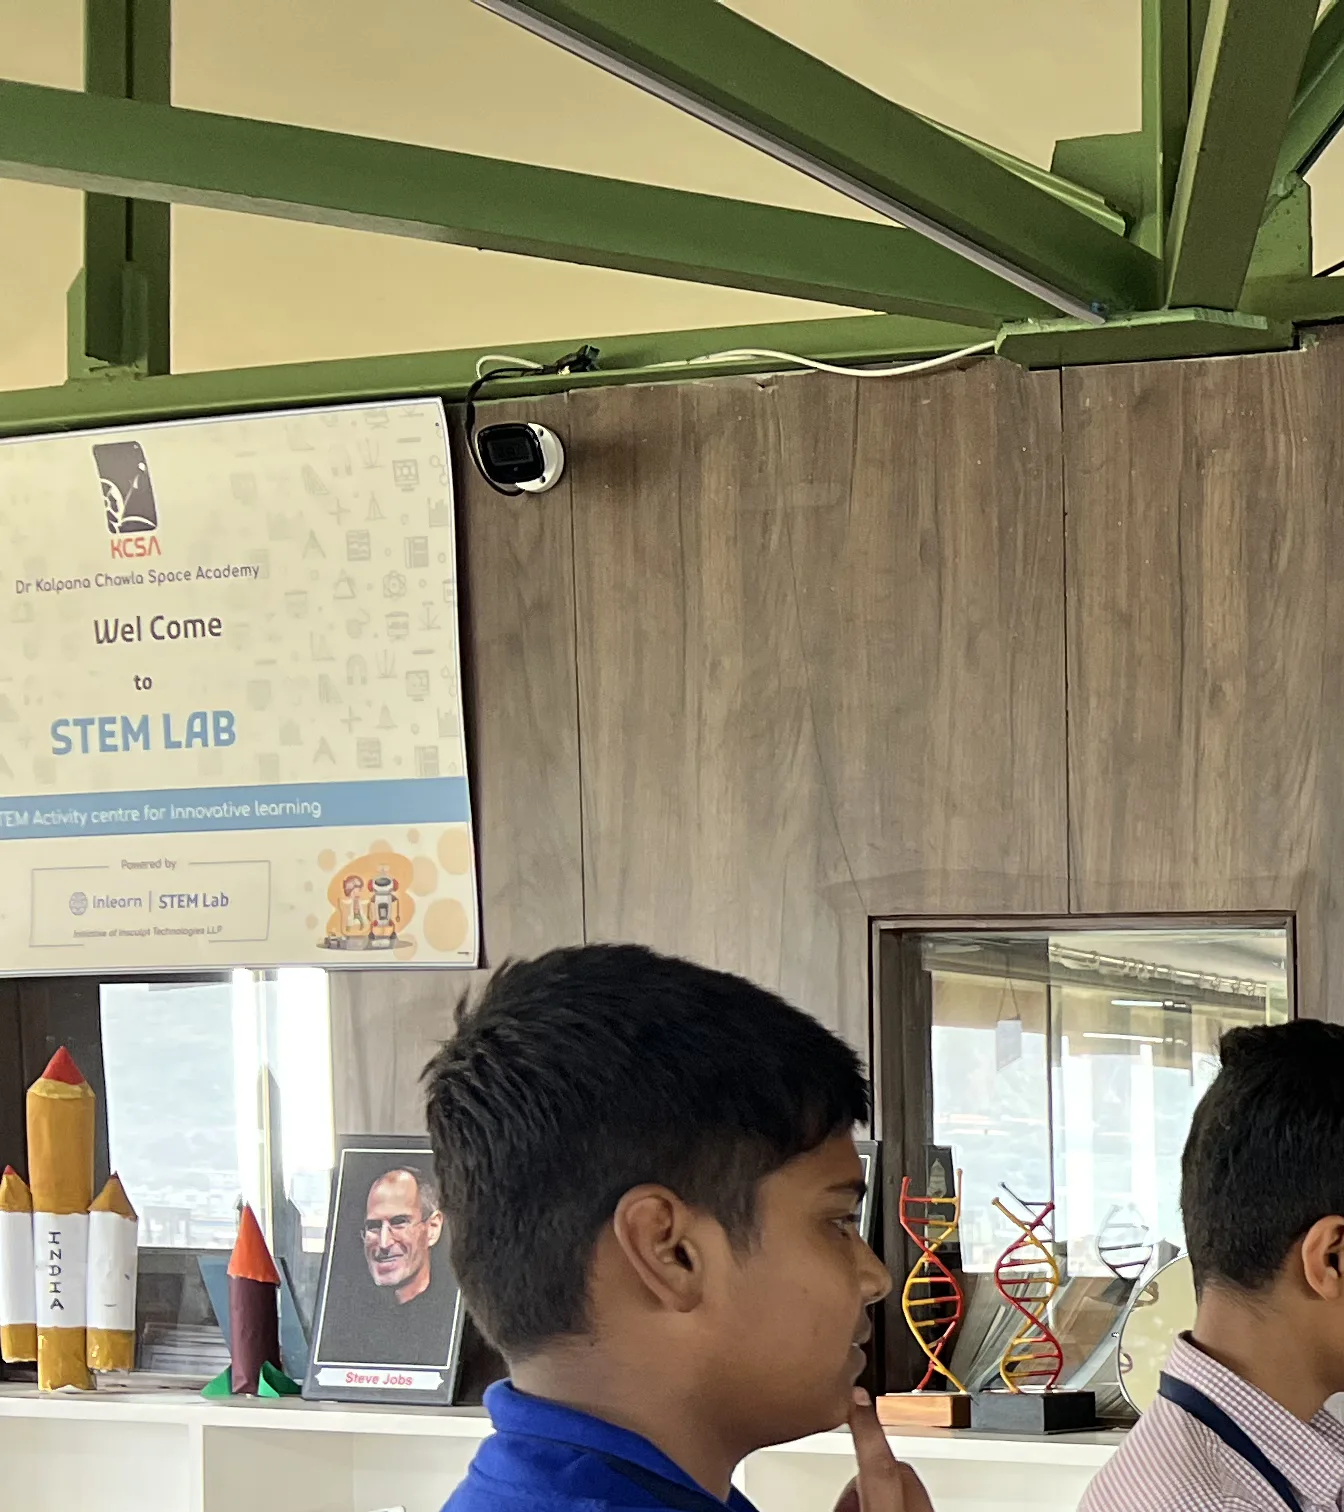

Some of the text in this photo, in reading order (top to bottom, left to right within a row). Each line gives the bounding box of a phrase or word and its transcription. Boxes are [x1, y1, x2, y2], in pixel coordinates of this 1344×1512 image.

[110, 536, 162, 559] KCSA
[15, 564, 260, 594] Dr Kalpana Chawla Space Academy
[93, 615, 222, 644] Wel Come
[133, 674, 153, 691] to
[50, 709, 236, 756] STEM LAB
[0, 810, 29, 827] TEM
[33, 808, 88, 828] Activity
[91, 807, 140, 824] centre
[144, 804, 166, 820] for
[254, 798, 322, 818] learning
[165, 857, 177, 870] by
[159, 893, 198, 909] STEM
[202, 892, 229, 908] Lab
[48, 1231, 64, 1311] INDIA
[345, 1371, 414, 1386] Steve Jobs
